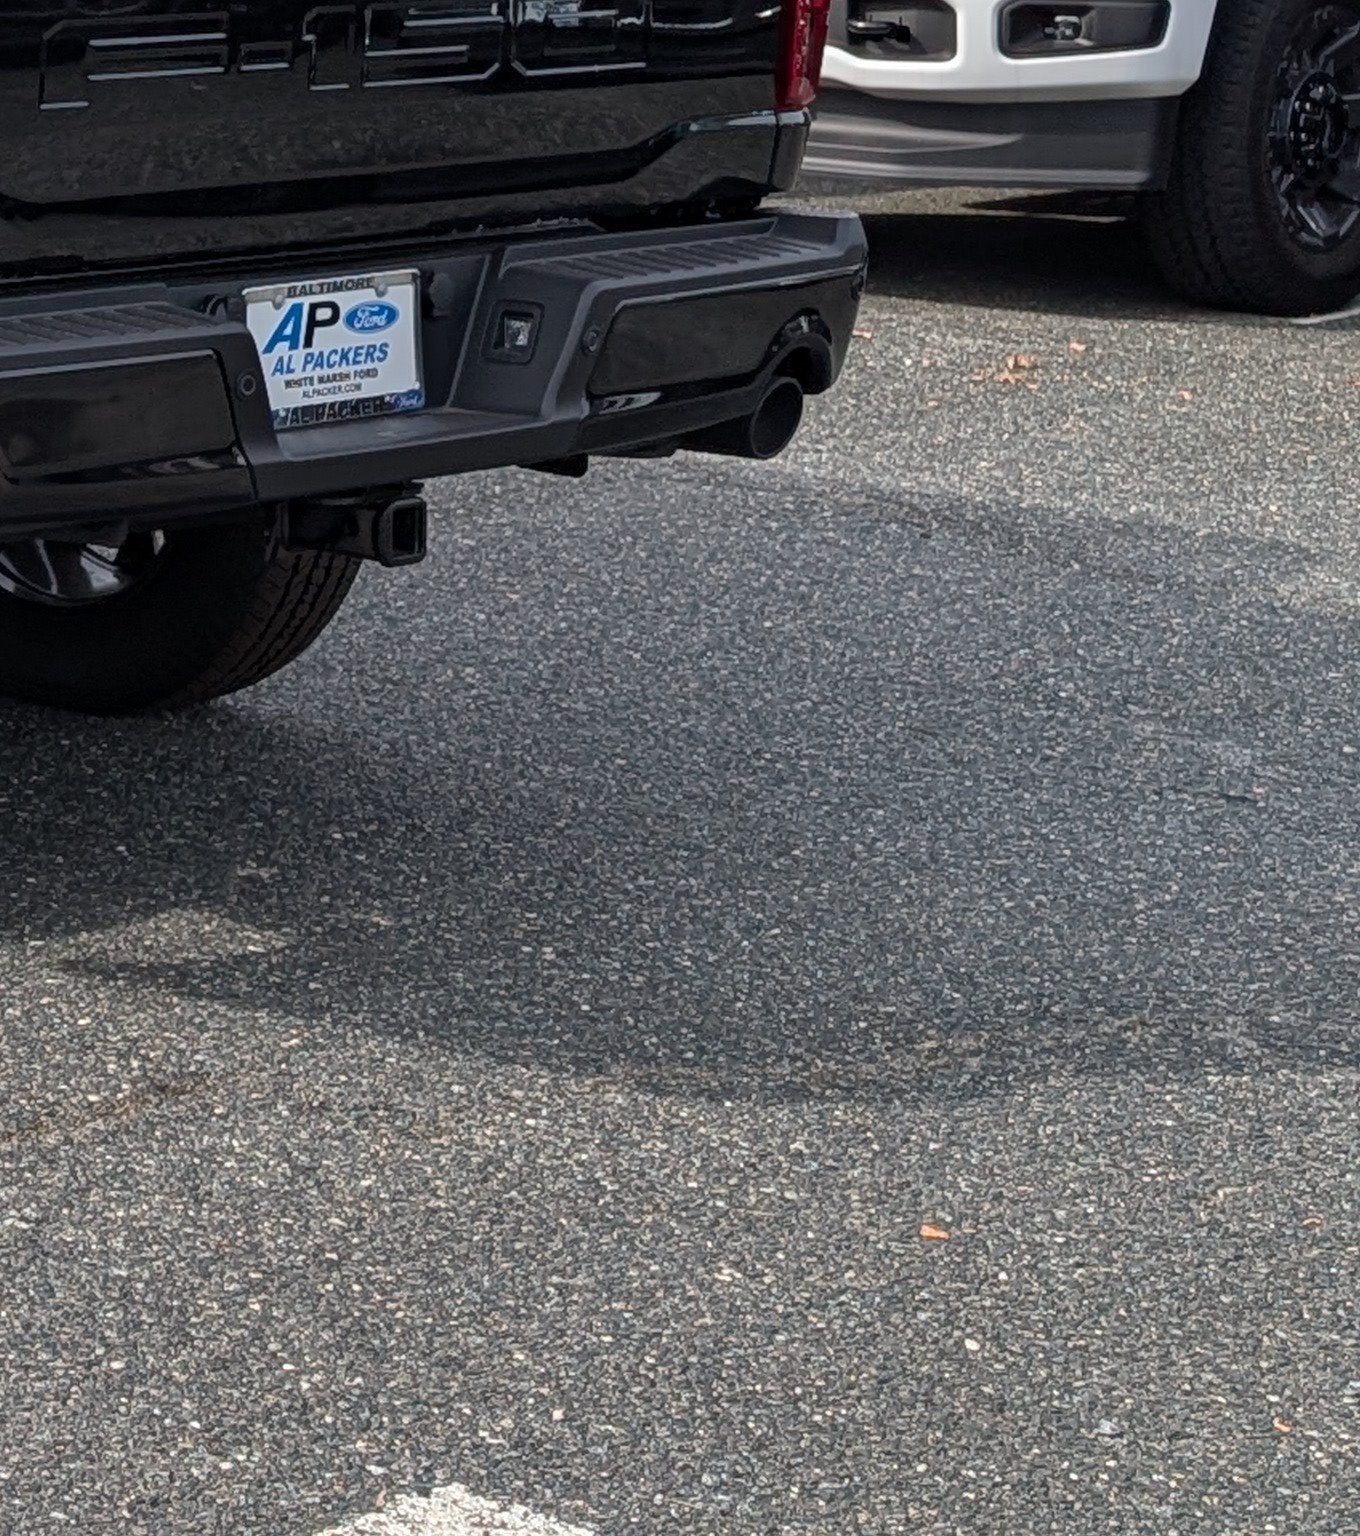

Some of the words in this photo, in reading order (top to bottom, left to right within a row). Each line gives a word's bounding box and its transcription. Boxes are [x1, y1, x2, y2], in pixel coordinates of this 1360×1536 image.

[287, 276, 376, 299] BALTIMORE
[261, 300, 341, 355] AP
[271, 353, 296, 377] AL
[301, 342, 390, 373] PACKERS
[284, 376, 315, 390] WHITE
[317, 371, 352, 385] MARSH
[353, 368, 379, 380] FORD
[302, 382, 362, 400] ALPACKER.COM
